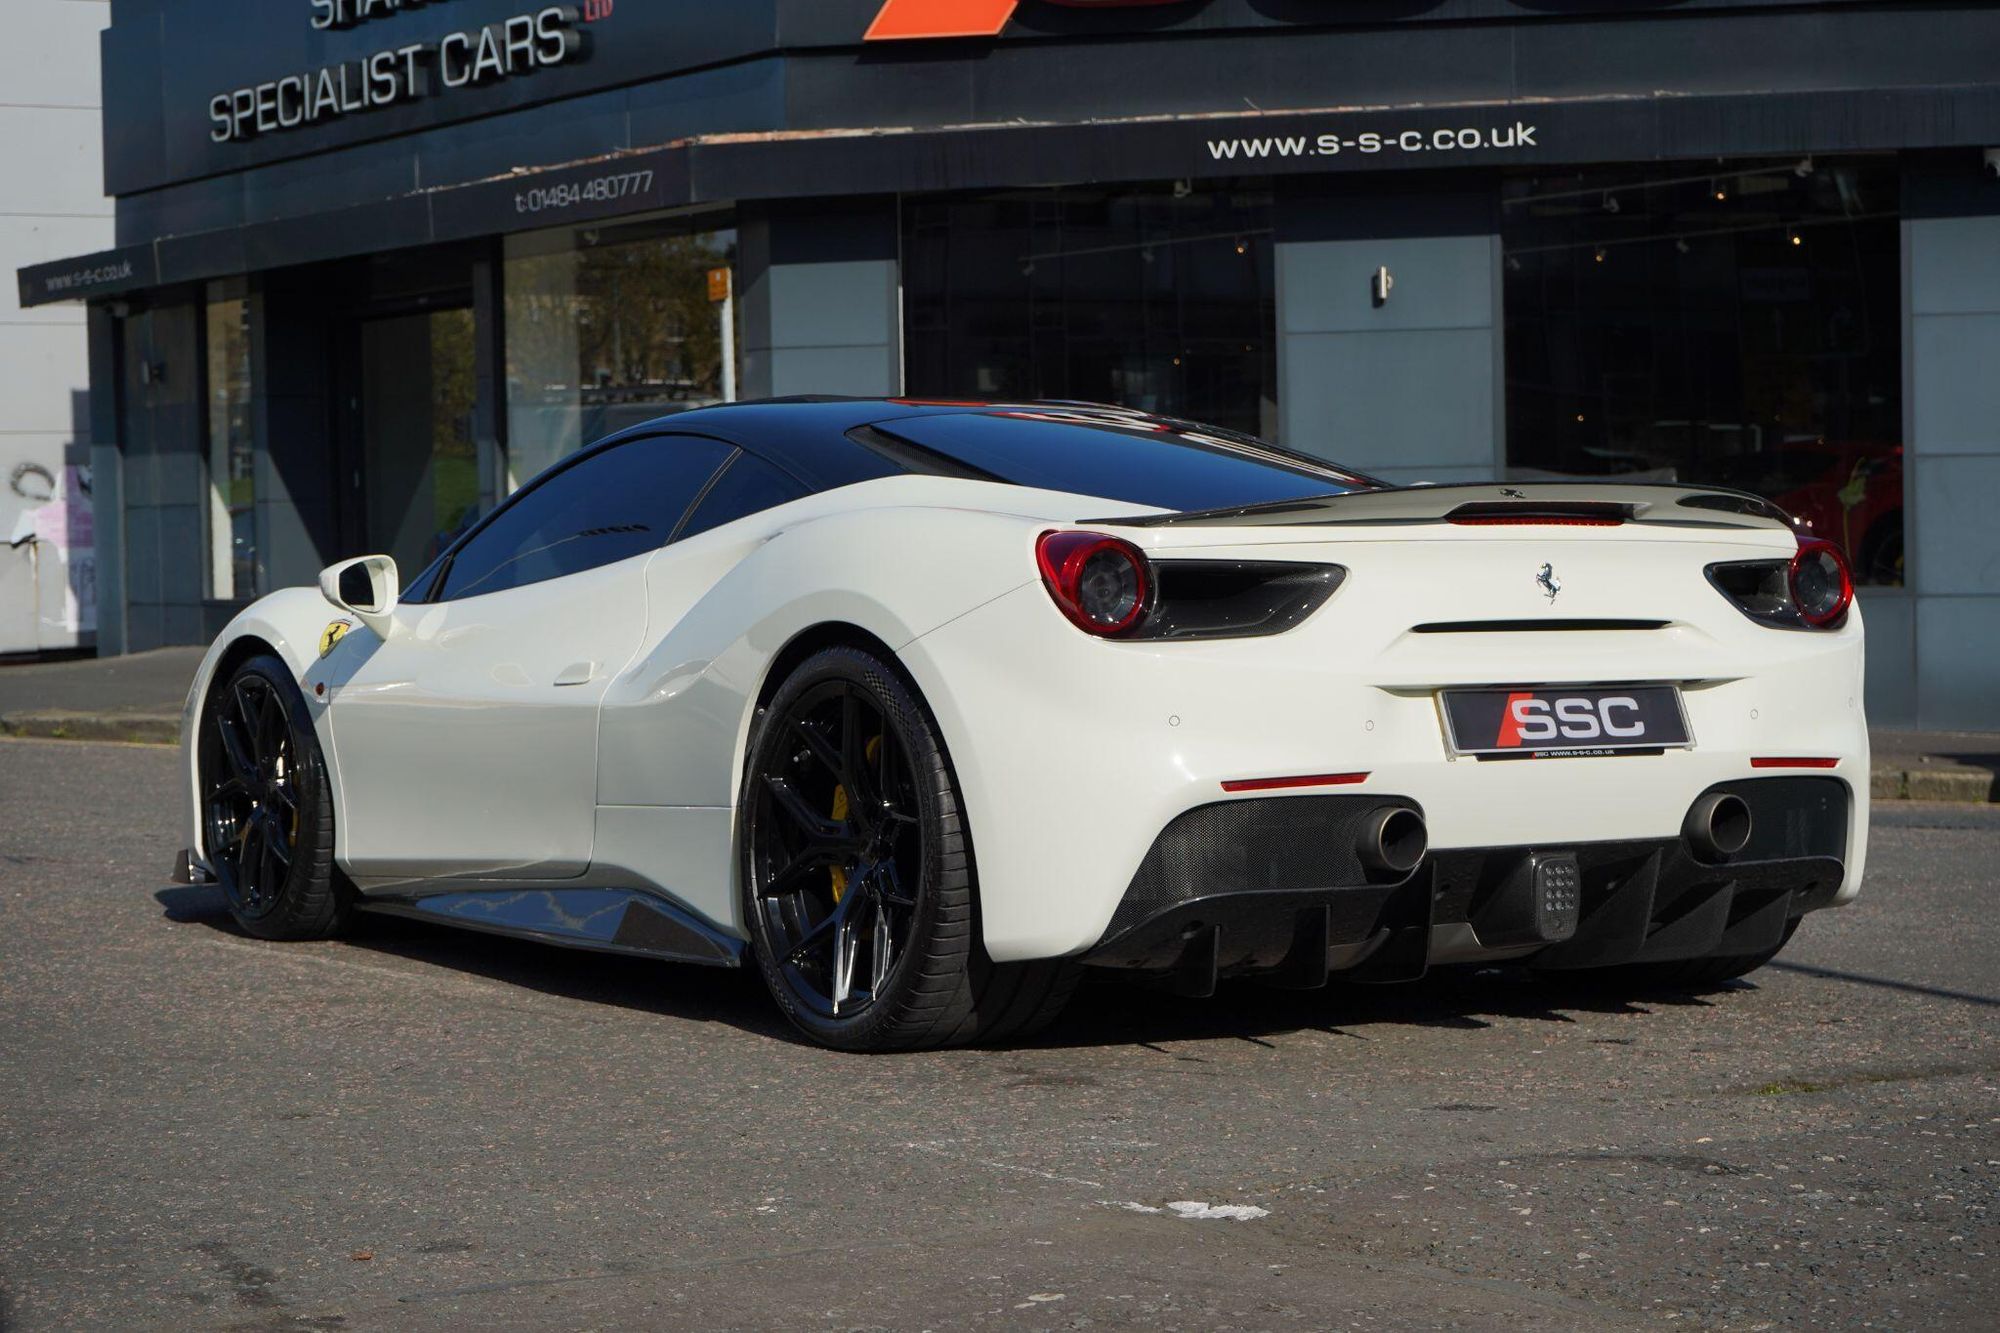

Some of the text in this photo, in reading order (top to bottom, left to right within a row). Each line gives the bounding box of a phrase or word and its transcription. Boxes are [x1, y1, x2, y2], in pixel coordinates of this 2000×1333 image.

[210, 0, 613, 142] SPECIALIST CARS LTD
[1207, 121, 1537, 159] www.s-s-c.co.uk
[582, 170, 653, 201] 480777
[1511, 697, 1645, 740] SSC
